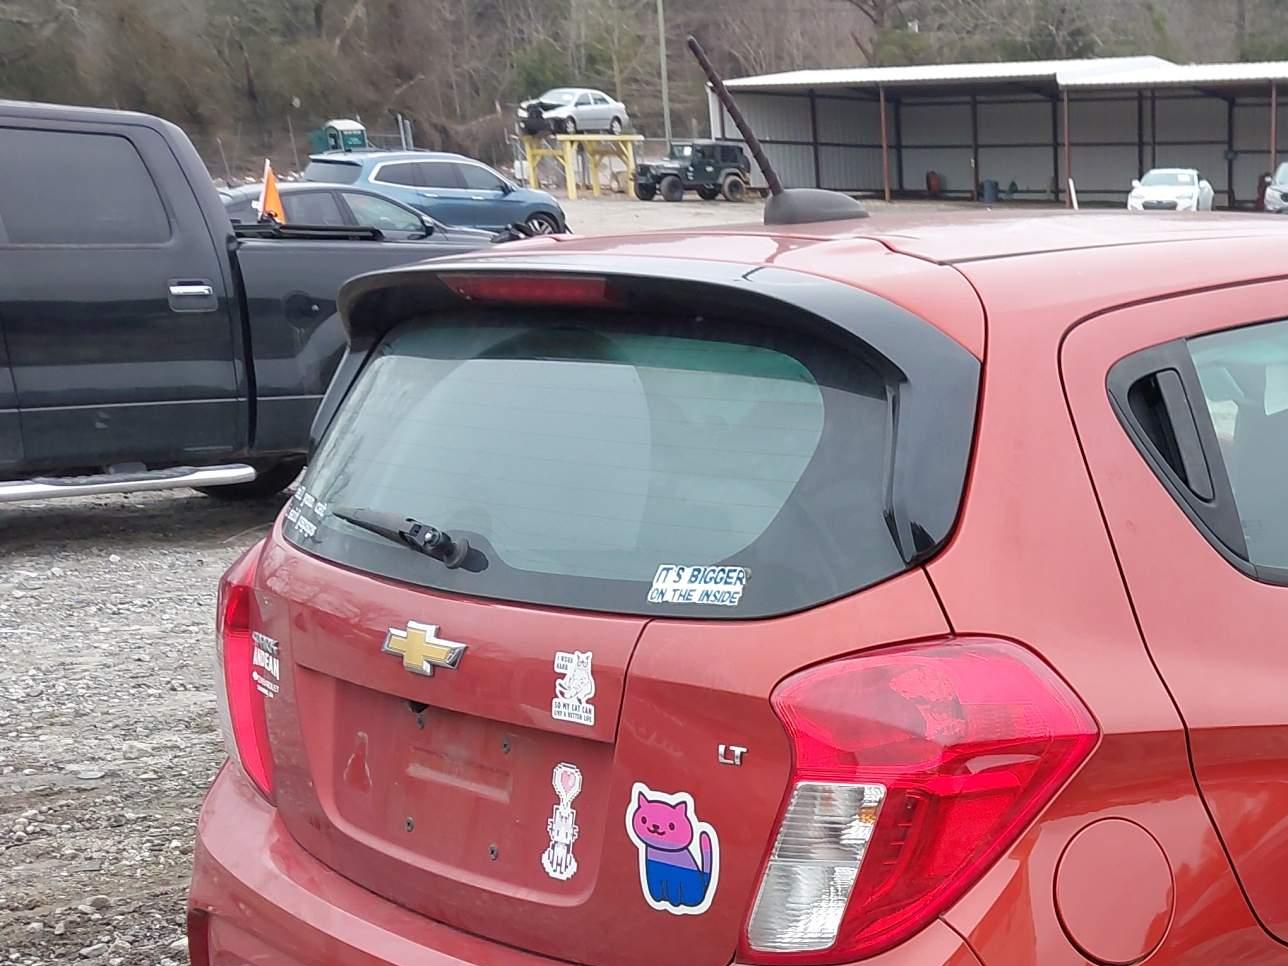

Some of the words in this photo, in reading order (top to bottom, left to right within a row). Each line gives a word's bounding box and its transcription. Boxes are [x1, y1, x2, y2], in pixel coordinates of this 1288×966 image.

[687, 568, 745, 586] BIGGER
[650, 588, 667, 601] ON
[671, 588, 696, 601] THE
[698, 589, 740, 604] INSIDE
[571, 704, 581, 712] CAT
[582, 705, 593, 715] CAN
[718, 744, 748, 765] LT
